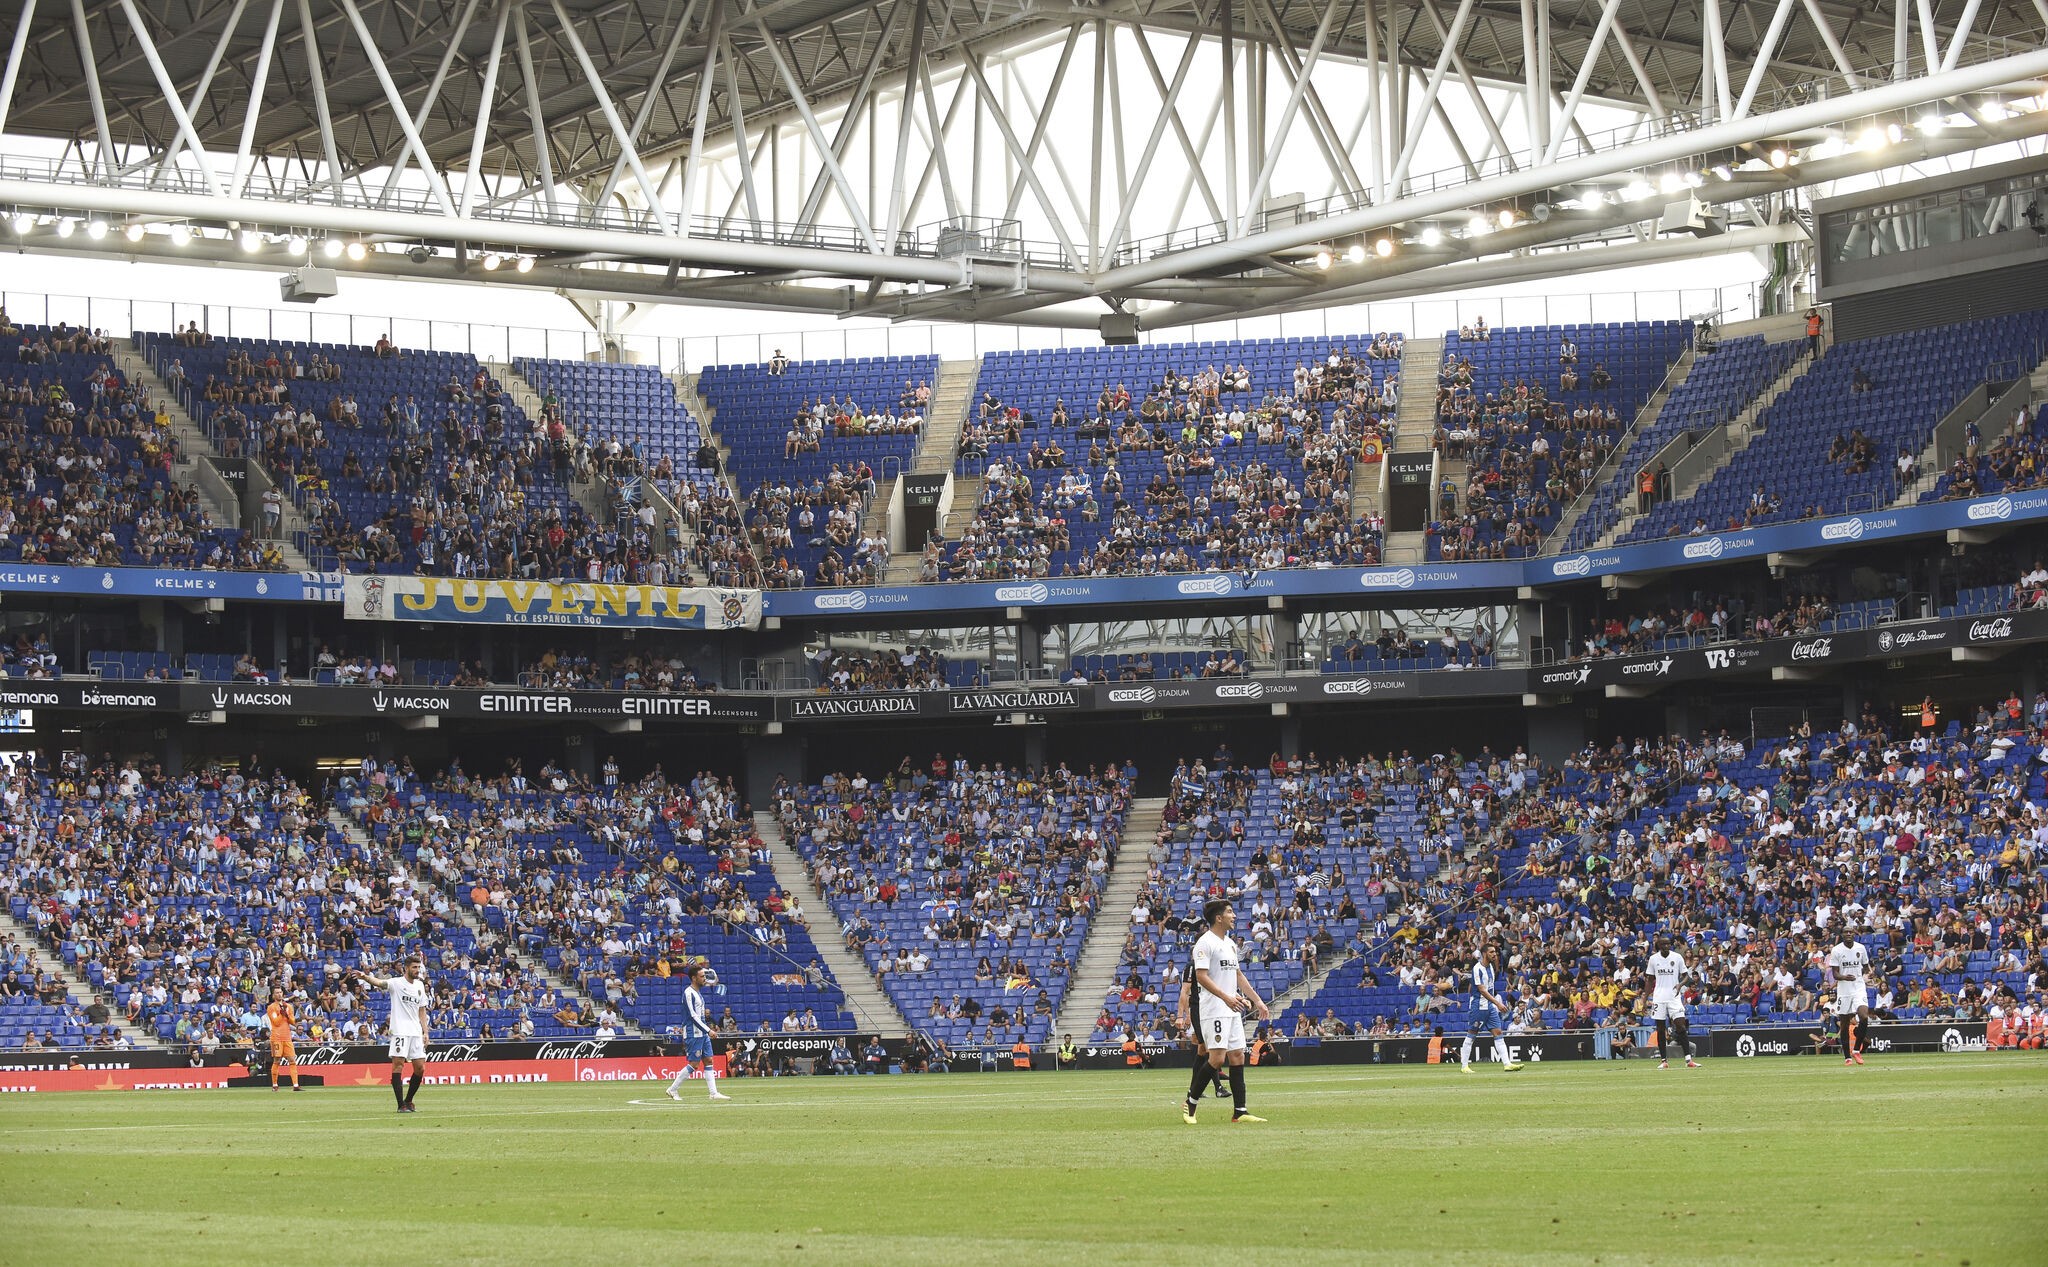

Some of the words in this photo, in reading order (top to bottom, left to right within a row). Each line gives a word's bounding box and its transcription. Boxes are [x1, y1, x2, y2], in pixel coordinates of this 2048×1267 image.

[219, 471, 245, 479] LME
[1391, 464, 1432, 473] KELME
[1972, 504, 1996, 517] RCDE
[2013, 498, 2048, 511] STADIUM
[1825, 524, 1848, 537] RCDE
[1864, 518, 1897, 530] STADIUM
[1687, 544, 1709, 556] RCDE
[1724, 538, 1755, 550] STADIUM
[1556, 562, 1577, 573] RCDE
[1591, 556, 1621, 568] STADIUM
[0, 573, 47, 584] KELME
[155, 578, 204, 589] KELME
[1366, 573, 1396, 585] RCDE
[1417, 572, 1458, 582] STADIUM
[1183, 581, 1212, 592] RCDE
[1234, 579, 1274, 588] STDIUM
[402, 578, 699, 619] JUVENIL
[1000, 588, 1029, 599] RCDE
[1050, 587, 1090, 597] STADIUM
[820, 595, 848, 606] RCDE
[869, 594, 909, 603] STADIUM
[1622, 659, 1660, 675] aramark
[1542, 668, 1579, 683] aramark
[1220, 685, 1247, 696] RCDE
[1264, 684, 1298, 694] STADIUM
[1327, 682, 1355, 693] RCDE
[1372, 680, 1406, 690] STADIUM
[233, 693, 292, 706] MACSON
[973, 690, 1076, 708] VANGUARDIA
[1112, 690, 1140, 701] RCDE
[1157, 688, 1190, 698] STADIUM
[393, 697, 450, 710] MACSON
[814, 697, 916, 715] VANGUARDIA
[1214, 1020, 1222, 1033] 8
[395, 1037, 405, 1047] 21
[1758, 1041, 1788, 1054] LaLiga
